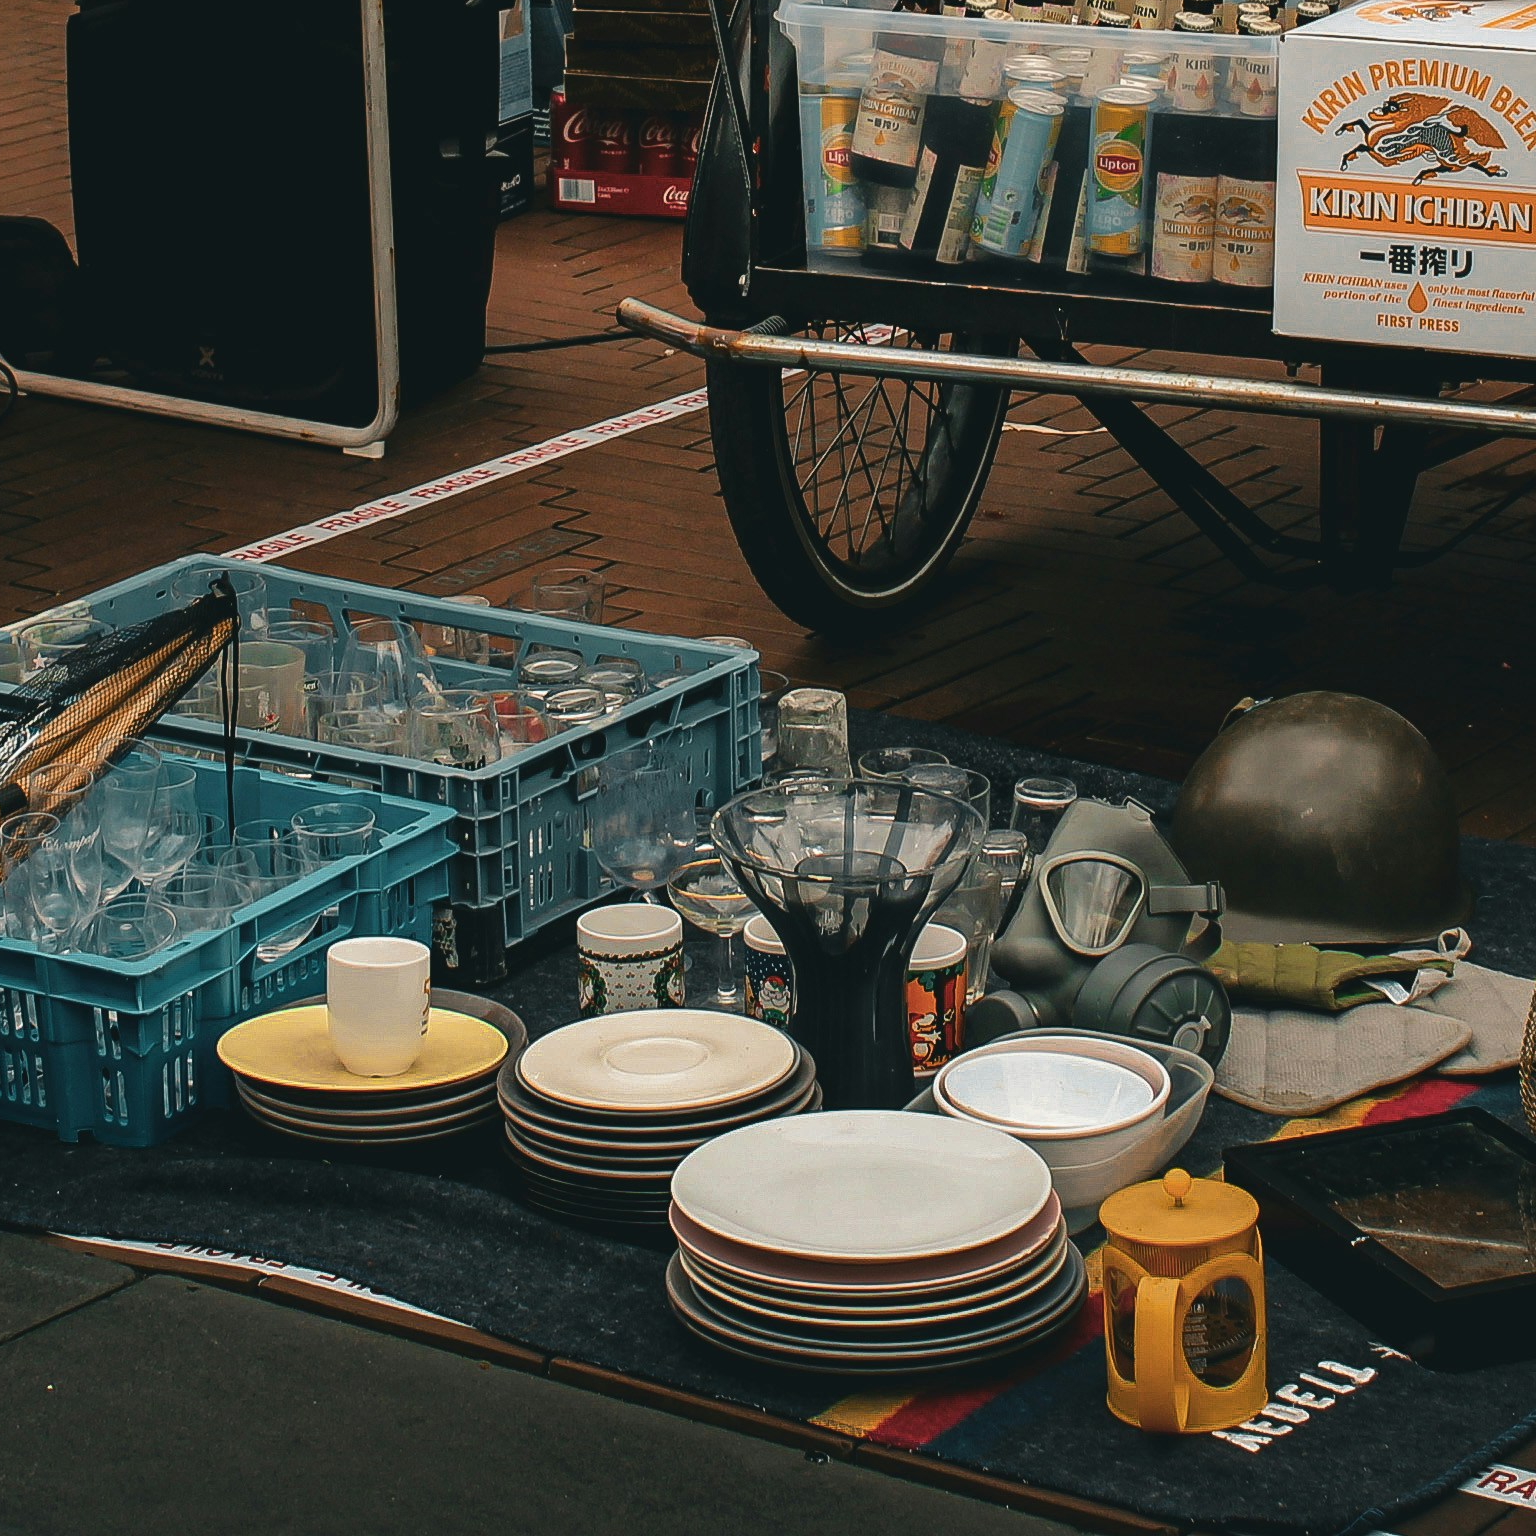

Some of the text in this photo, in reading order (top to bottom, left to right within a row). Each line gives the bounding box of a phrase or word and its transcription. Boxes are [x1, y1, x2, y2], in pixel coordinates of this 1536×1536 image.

[1302, 70, 1369, 135] KIRIN
[1369, 58, 1491, 102] PREMIUM
[1100, 157, 1137, 171] Lipton
[1308, 186, 1533, 234] KIRIN ICHIBAN
[1303, 272, 1335, 285] KIRIN
[1336, 274, 1383, 289] ICHIBAN
[1427, 284, 1448, 298] only
[1448, 285, 1465, 297] the
[1466, 288, 1491, 300] most
[1323, 289, 1363, 305] portion
[1364, 292, 1380, 305] of
[1380, 293, 1402, 305] the
[1377, 313, 1460, 334] FIRST PRESS
[316, 407, 673, 534] FRAGILE FRAGILE FRAGILE FRAGILE
